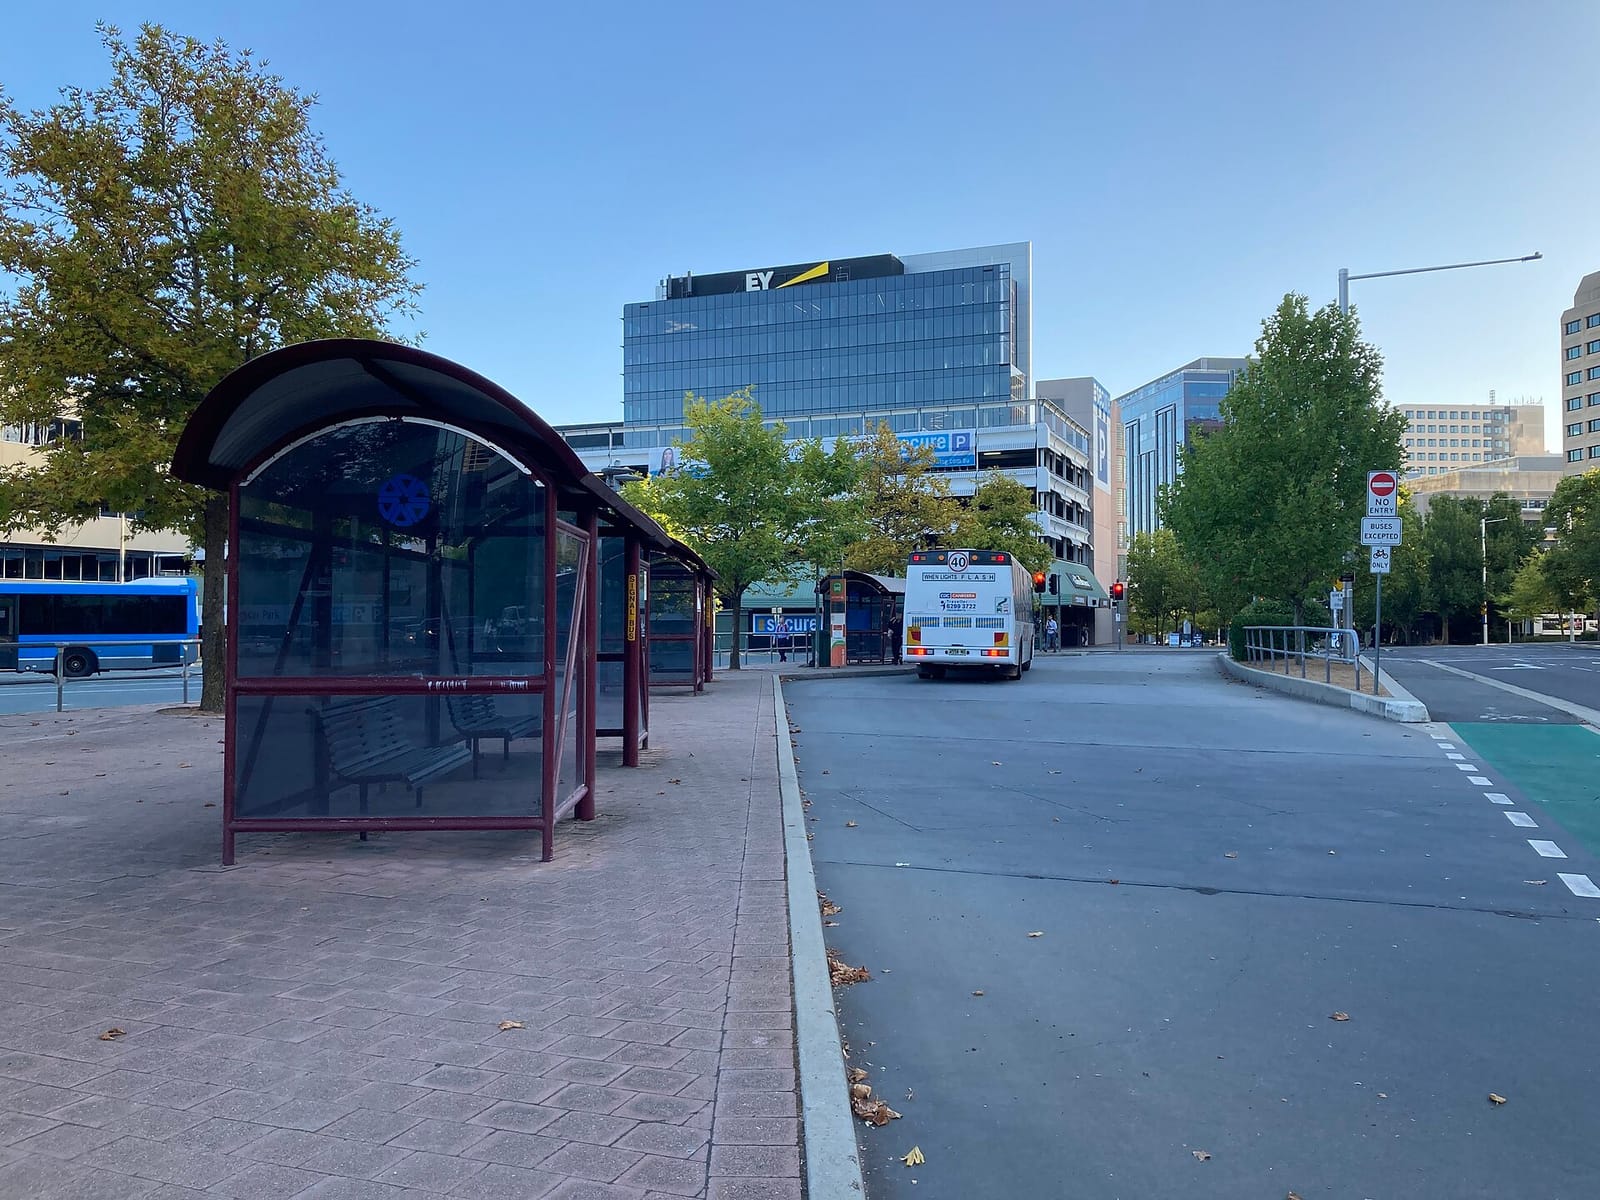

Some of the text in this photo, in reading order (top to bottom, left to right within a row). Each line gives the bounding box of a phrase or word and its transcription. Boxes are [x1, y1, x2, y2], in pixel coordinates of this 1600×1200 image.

[745, 271, 774, 292] EY
[898, 435, 966, 450] cure P
[1099, 428, 1106, 472] P
[1375, 498, 1390, 506] NO
[950, 557, 966, 568] 40
[767, 618, 817, 632] scure
